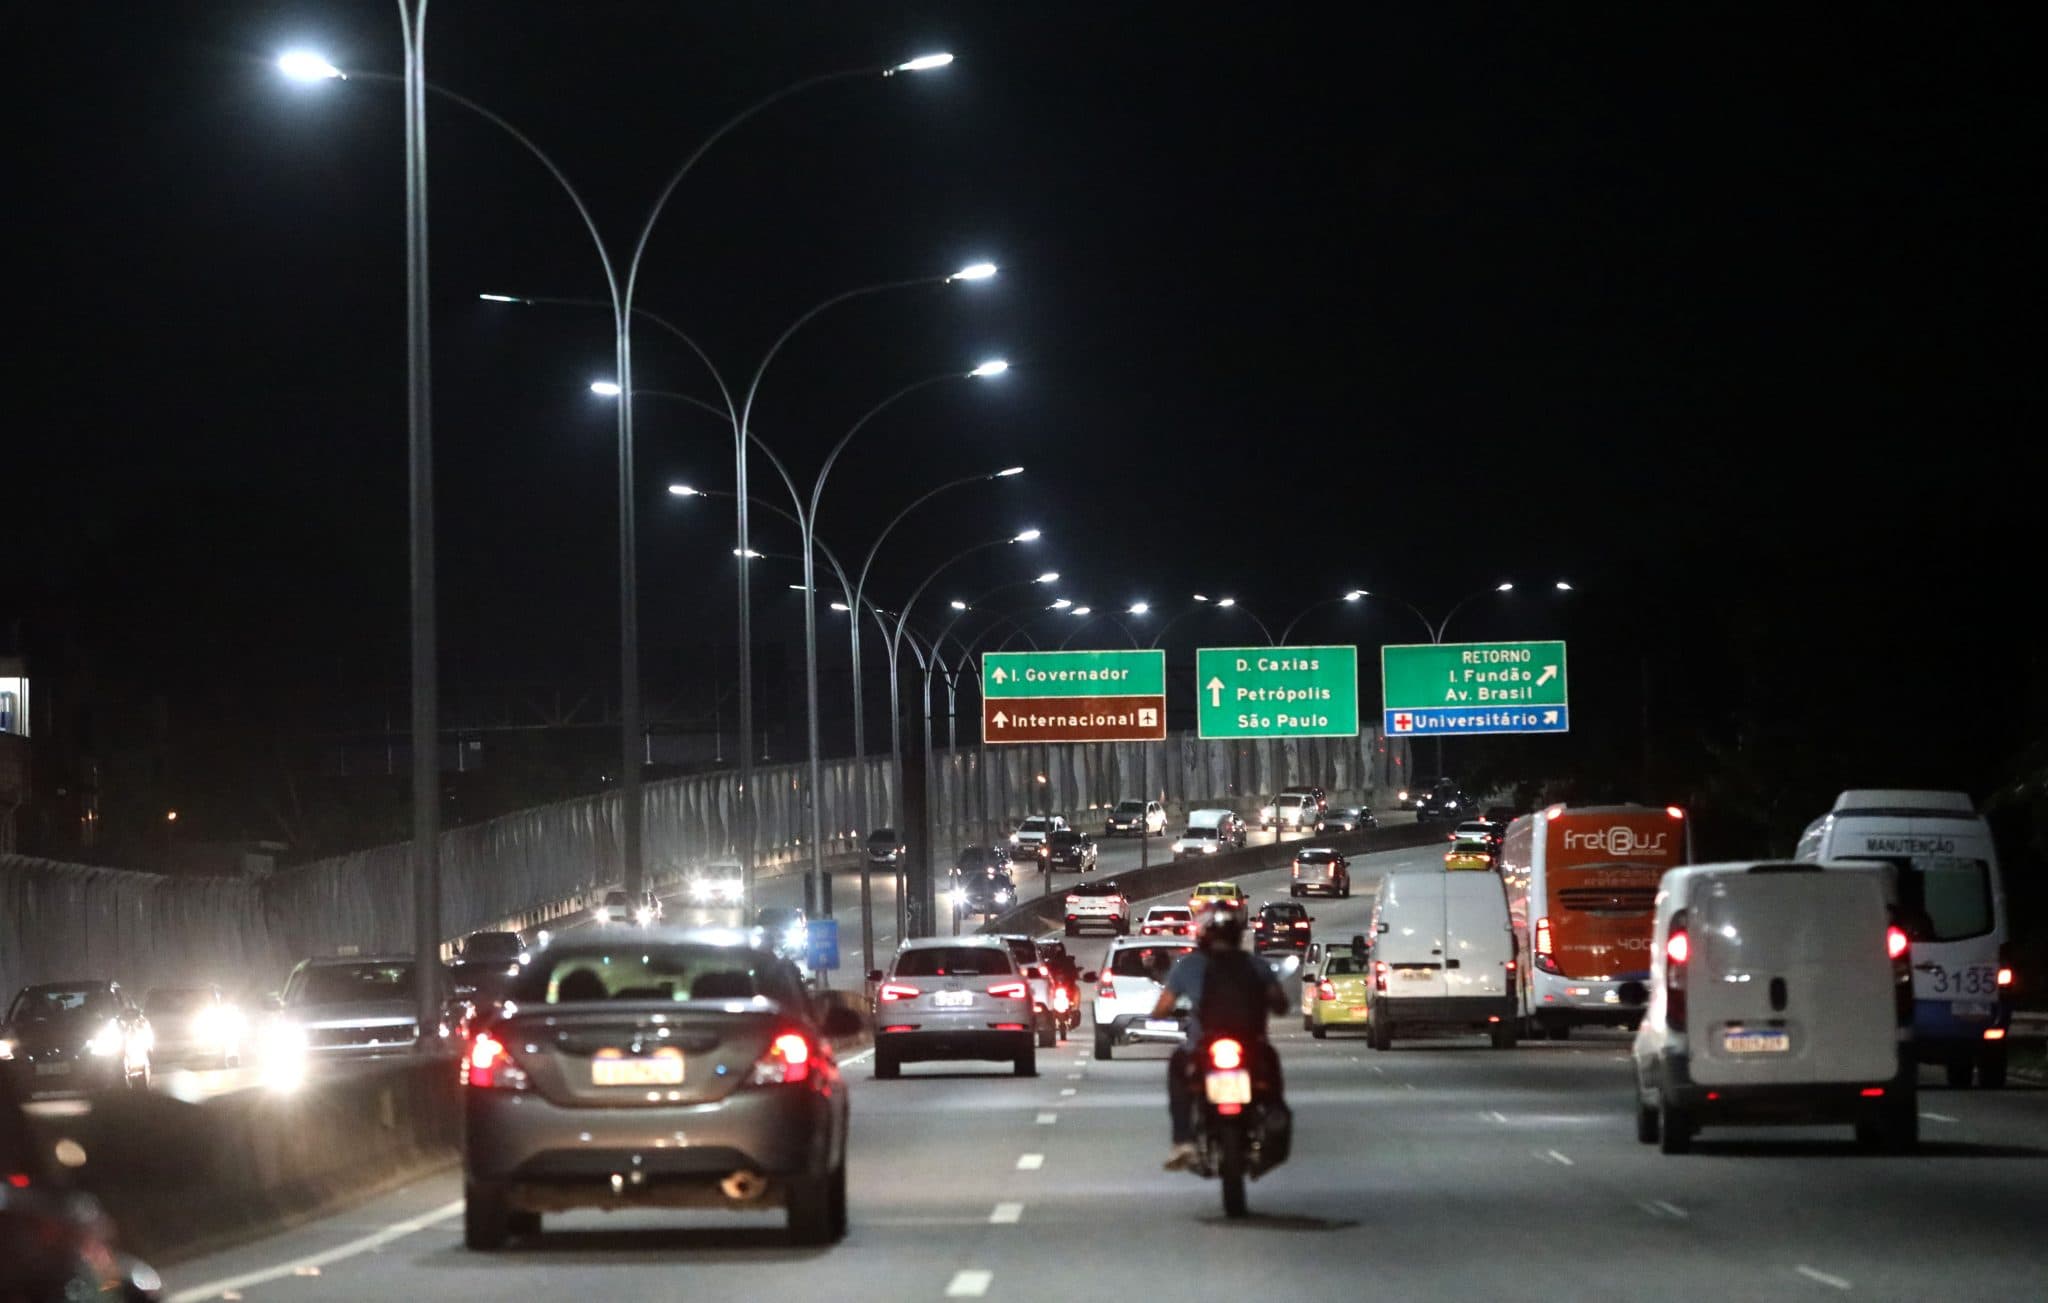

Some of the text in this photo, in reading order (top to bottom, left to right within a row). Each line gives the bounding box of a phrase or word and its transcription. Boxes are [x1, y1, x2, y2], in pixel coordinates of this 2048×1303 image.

[1462, 650, 1531, 664] RETORNO
[1236, 658, 1319, 672] D. Caxias
[1012, 667, 1129, 682] I. Governador
[1450, 668, 1532, 683] I. Fundão
[1237, 686, 1331, 703] Petrópolis
[1445, 686, 1532, 701] Av. Brasil
[1012, 713, 1134, 727] Internacional
[1238, 713, 1328, 728] São Paulo
[1415, 712, 1537, 728] Universitário
[1867, 836, 1955, 857] MANUTENÇÃO
[1934, 971, 1995, 994] 3135
